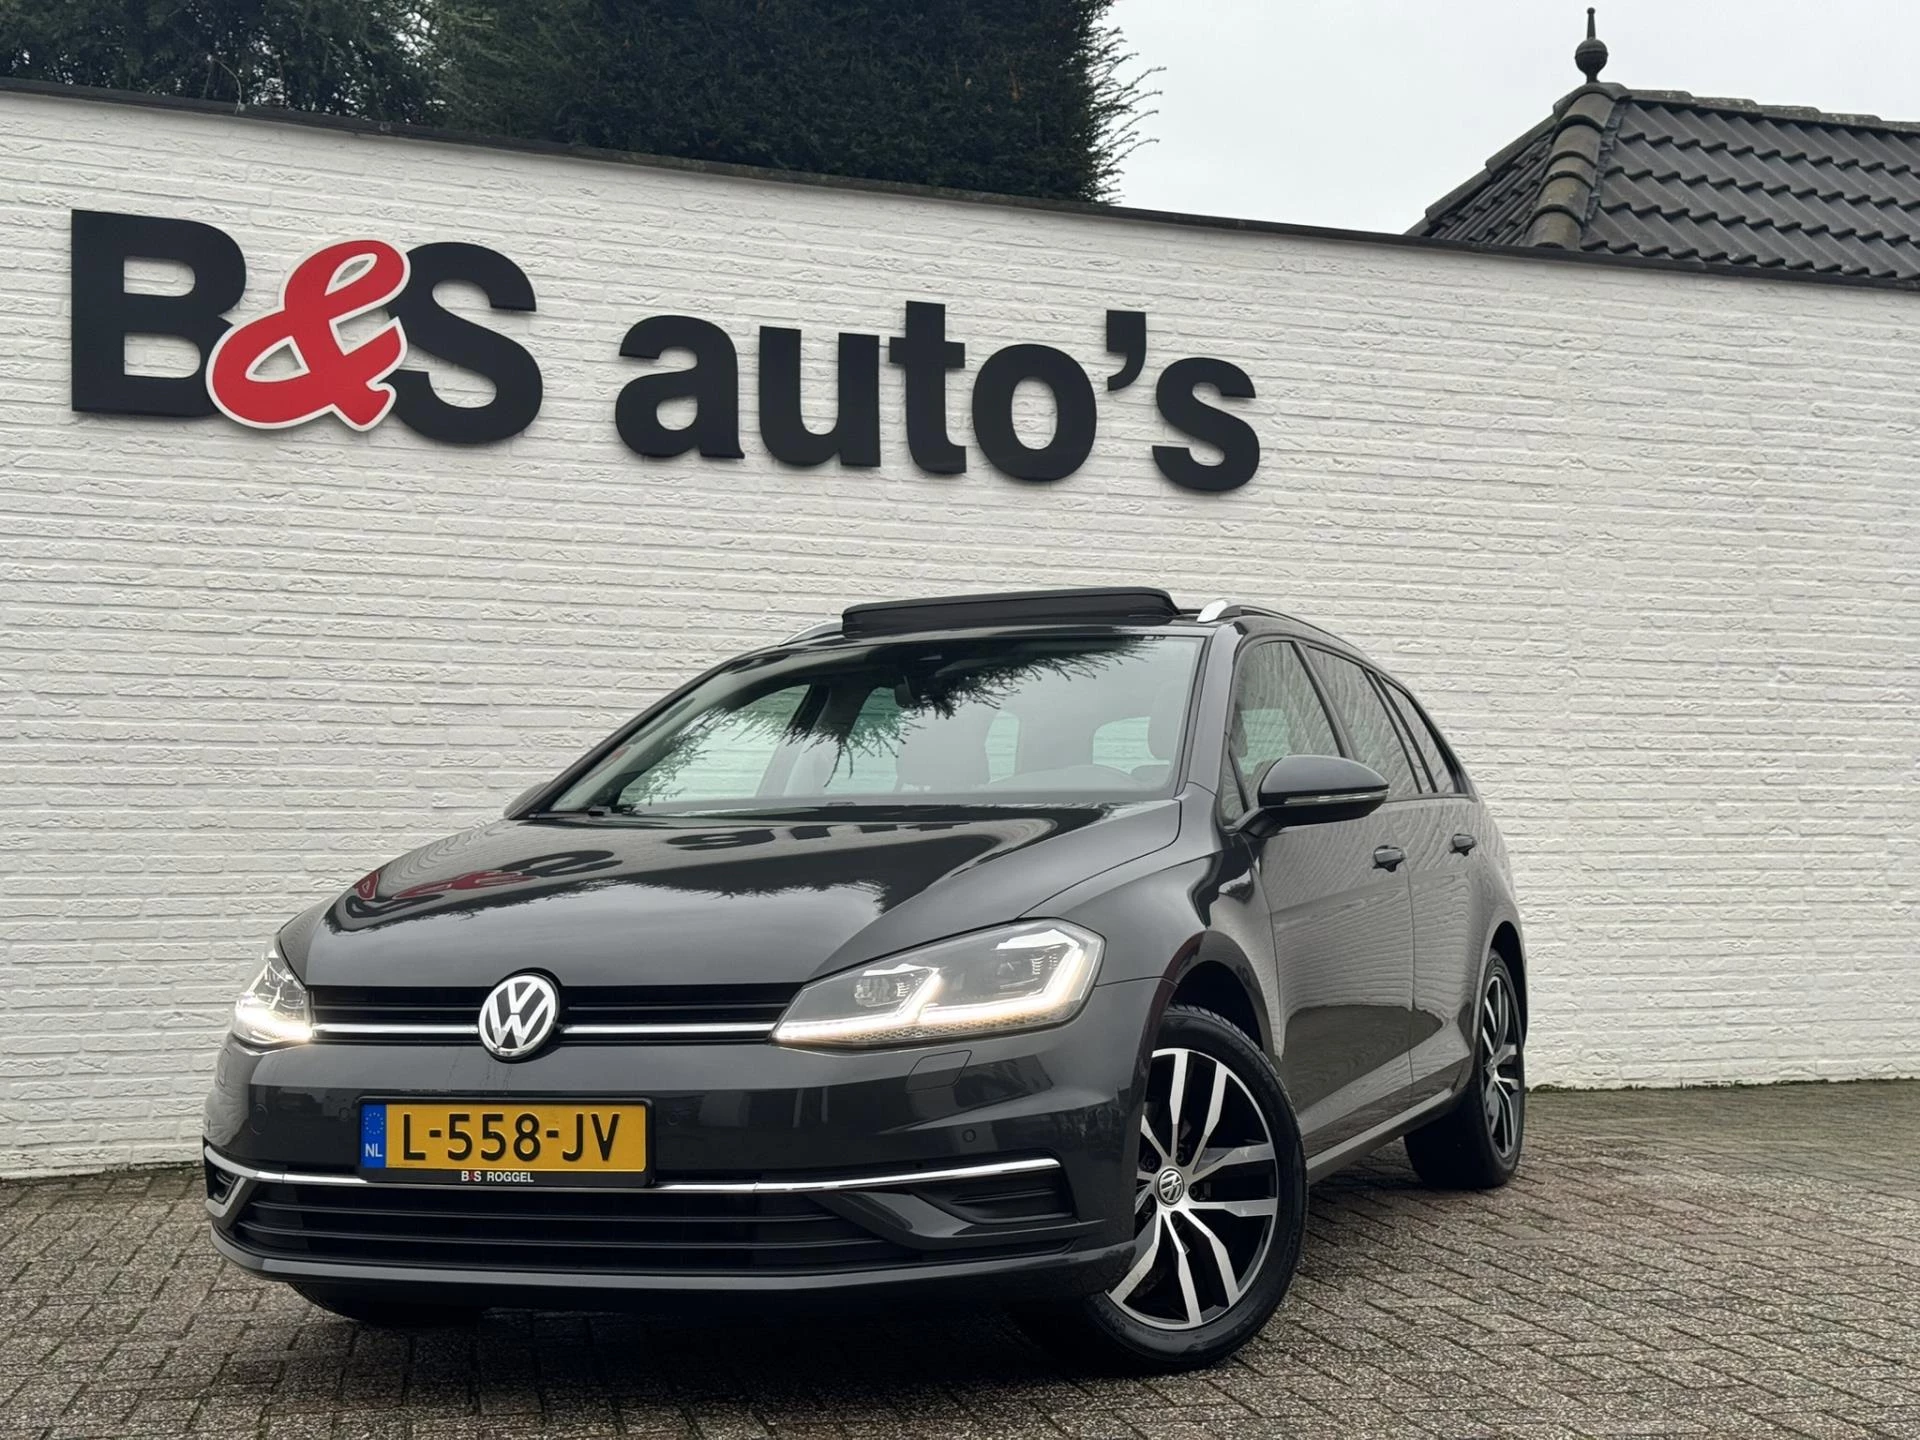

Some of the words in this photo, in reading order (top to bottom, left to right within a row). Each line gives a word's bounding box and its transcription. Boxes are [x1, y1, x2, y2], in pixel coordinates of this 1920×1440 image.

[72, 209, 542, 444] B&S
[615, 301, 1260, 492] auto's
[479, 975, 557, 1057] VW
[364, 1143, 383, 1158] NL
[402, 1112, 621, 1162] L-558-JV
[486, 1171, 535, 1184] ROGGEL
